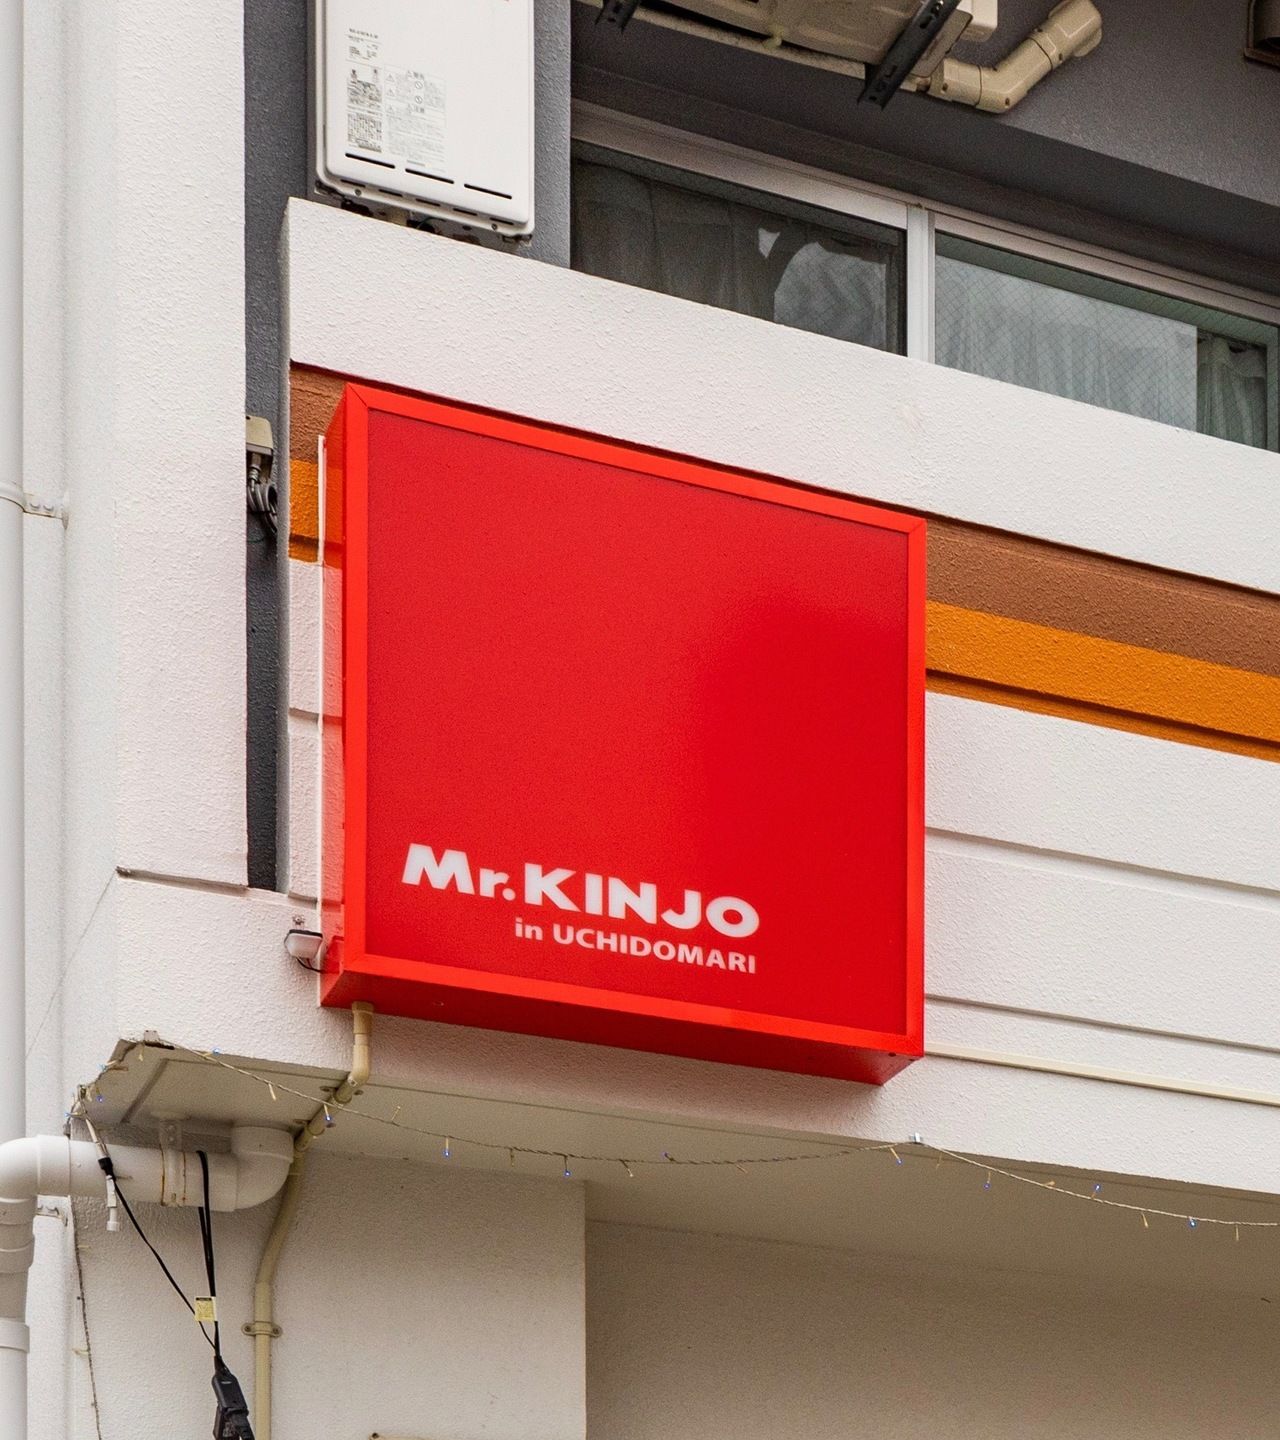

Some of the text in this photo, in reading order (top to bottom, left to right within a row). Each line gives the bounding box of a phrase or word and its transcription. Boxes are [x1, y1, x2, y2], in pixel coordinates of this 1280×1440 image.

[402, 842, 760, 938] Mr.KINJO
[515, 917, 755, 973] in UCHIDOMARI
